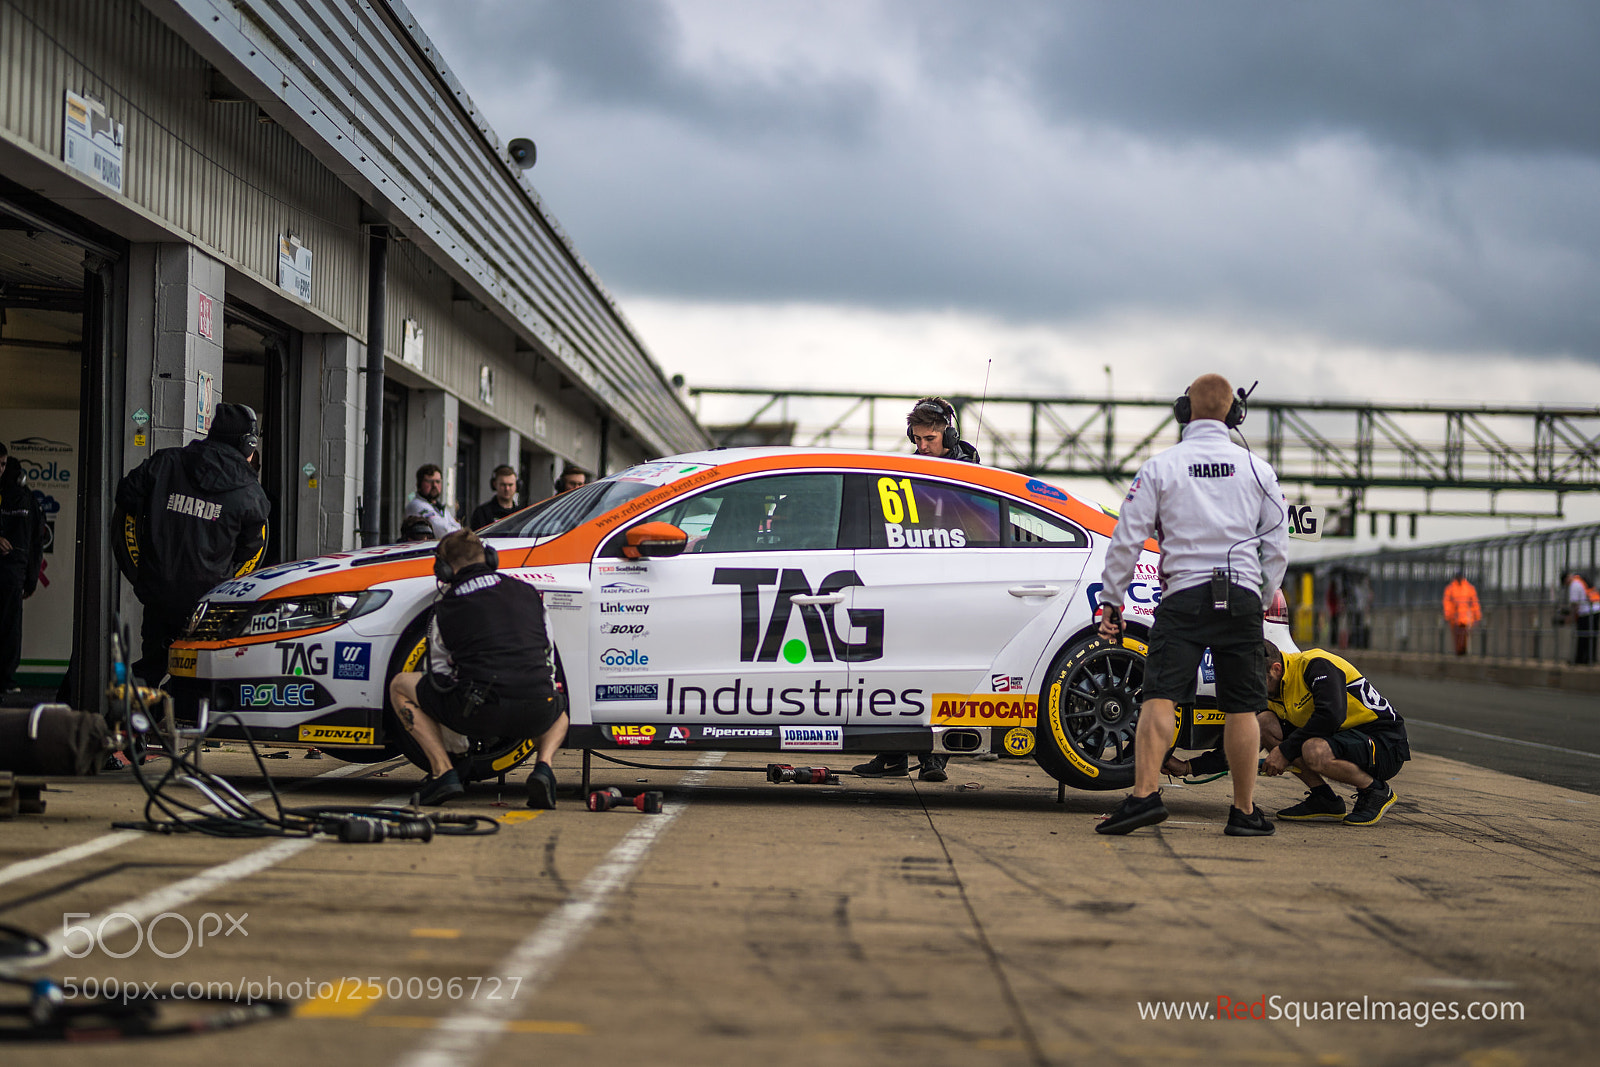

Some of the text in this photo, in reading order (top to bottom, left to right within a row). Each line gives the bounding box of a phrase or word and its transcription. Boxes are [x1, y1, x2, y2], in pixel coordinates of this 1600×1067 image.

[1193, 463, 1230, 478] HARD
[172, 493, 216, 520] HARD
[595, 469, 721, 528] www.reflections-kent.co.uk
[877, 476, 920, 524] 61
[884, 522, 967, 548] Burns
[459, 574, 497, 594] HARD
[600, 602, 650, 615] Linkway
[712, 567, 885, 663] TAG
[1133, 605, 1156, 616] Shee
[252, 613, 278, 632] HiQ
[610, 624, 645, 634] BOXO
[275, 642, 329, 676] TAG
[605, 649, 649, 666] oodle
[337, 670, 365, 678] COLLEGE
[338, 663, 366, 671] WESTON
[240, 684, 315, 706] ROLEC
[607, 685, 657, 694] MIDSHIRES
[666, 678, 926, 716] Industries
[937, 700, 1037, 719] AUTOCAR
[313, 729, 371, 740] DUNLOP
[611, 725, 657, 736] NEO
[702, 727, 773, 738] Pipercross
[784, 730, 839, 741] JORDAN RV
[1010, 737, 1028, 751] ZX1
